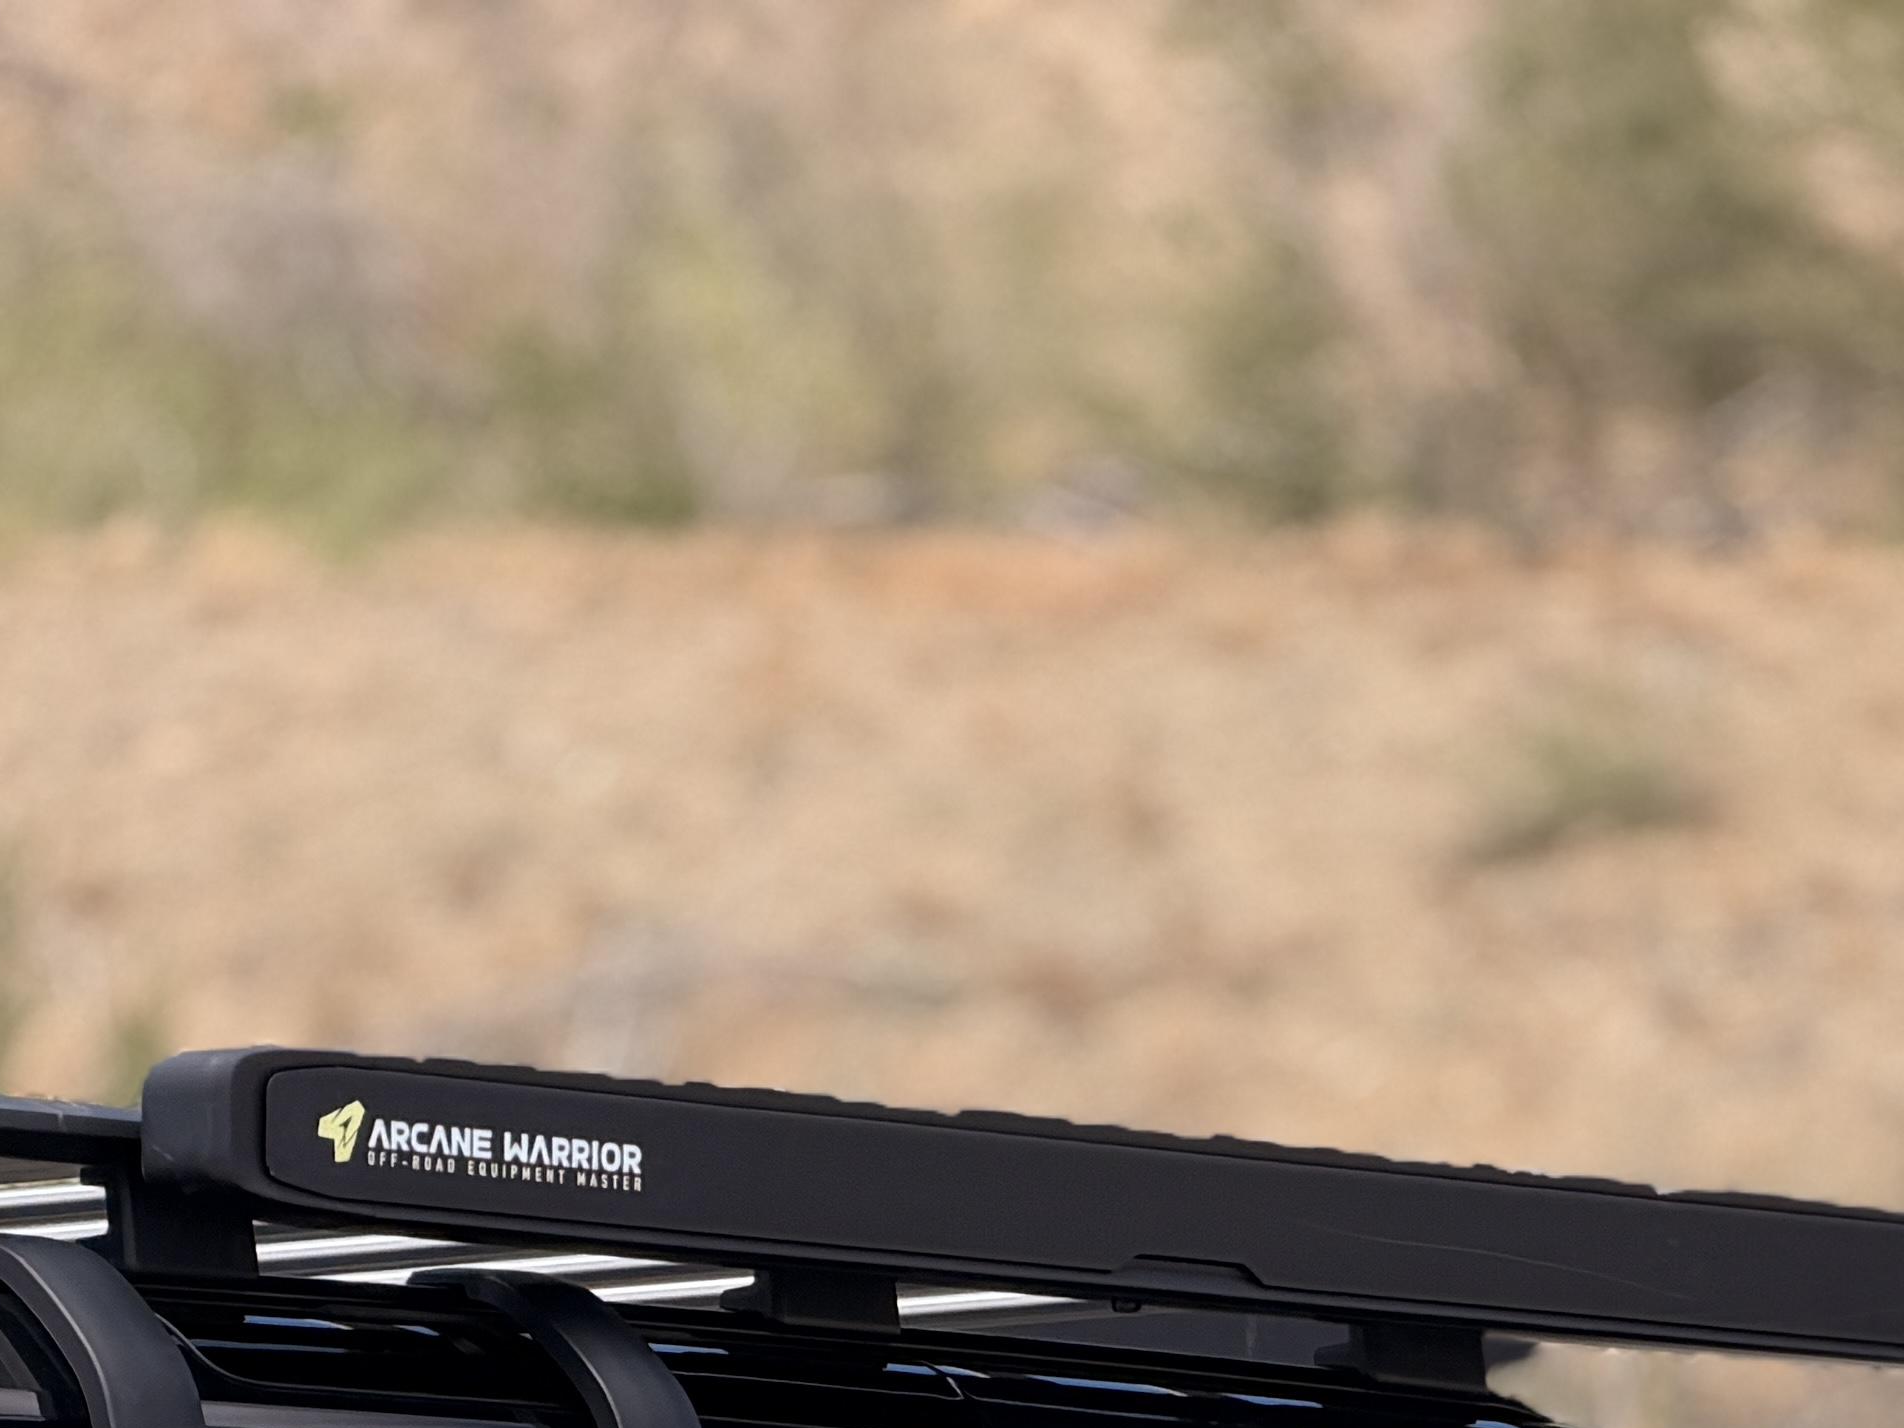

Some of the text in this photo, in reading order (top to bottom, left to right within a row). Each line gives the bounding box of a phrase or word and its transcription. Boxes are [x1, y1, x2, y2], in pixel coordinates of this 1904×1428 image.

[368, 1118, 643, 1174] ARCANE WARRIOR
[367, 1151, 643, 1192] OFF-ROAD EQUIPMENT MASTER
